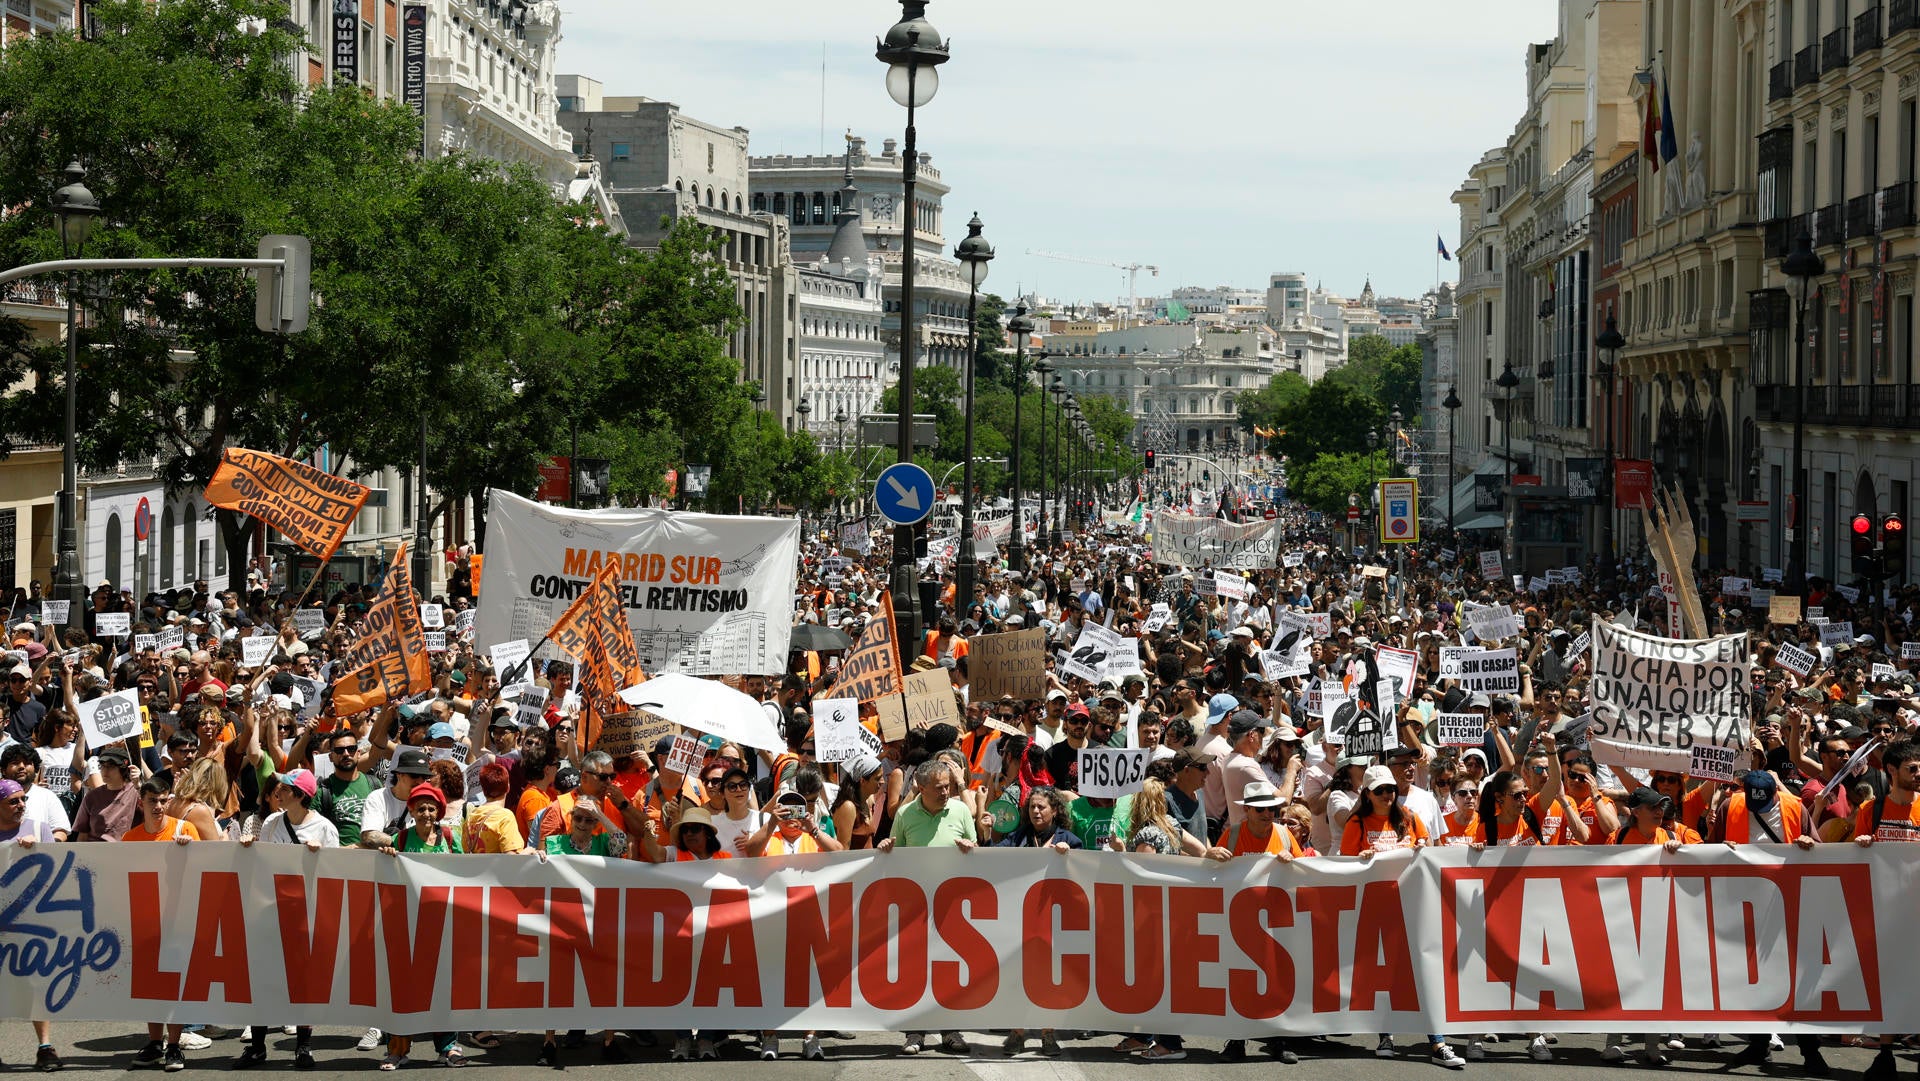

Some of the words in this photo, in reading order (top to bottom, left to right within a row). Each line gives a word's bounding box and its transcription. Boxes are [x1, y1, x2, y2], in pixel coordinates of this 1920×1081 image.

[407, 28, 423, 57] VIVAS
[1568, 472, 1581, 480] UNA
[1568, 480, 1588, 488] NOCHE
[1580, 488, 1597, 497] LUNA
[563, 548, 666, 583] MADRID
[670, 555, 722, 585] SUR
[646, 587, 748, 612] RENTISMO
[154, 626, 183, 643] DERECHO
[162, 634, 184, 648] TECHO
[1598, 624, 1707, 662] VECINOS
[1718, 638, 1747, 663] EN
[1781, 642, 1816, 666] DERECHO
[984, 660, 993, 672] Y
[1000, 657, 1036, 672] MENOS
[1462, 659, 1480, 674] SIN
[1481, 658, 1516, 672] CASA?
[1784, 654, 1811, 672] TECHO
[976, 676, 1043, 698] BUITRES
[1324, 682, 1336, 690] Con
[1462, 680, 1470, 690] A
[1470, 679, 1482, 691] LA
[1484, 676, 1518, 690] CALLE!
[1694, 664, 1746, 698] POR
[96, 702, 132, 720] STOP
[98, 713, 136, 732] DESAHUCIOS
[602, 713, 644, 729] ORREJÓN
[1440, 716, 1483, 727] DERECHO
[1592, 706, 1694, 749] SAREB
[596, 732, 632, 744] PRECIOS
[633, 724, 670, 740] ASEQUIBLES
[671, 722, 676, 732] Y
[1440, 728, 1446, 738] A
[1447, 728, 1483, 738] TECHO
[609, 743, 646, 755] VIVIENDA
[670, 751, 678, 760] A
[1693, 746, 1734, 762] DERECHO
[1082, 753, 1144, 788] PiS.O.S.
[1692, 759, 1699, 770] A
[1702, 760, 1733, 774] TECHO
[0, 850, 94, 939] 24
[129, 871, 251, 1004] LA
[274, 873, 762, 1014] VIVIENDA
[784, 876, 1000, 1012] NOS
[1022, 879, 1420, 1015] CUESTA
[1451, 876, 1585, 1012] LA
[1596, 876, 1872, 1012] VIDA
